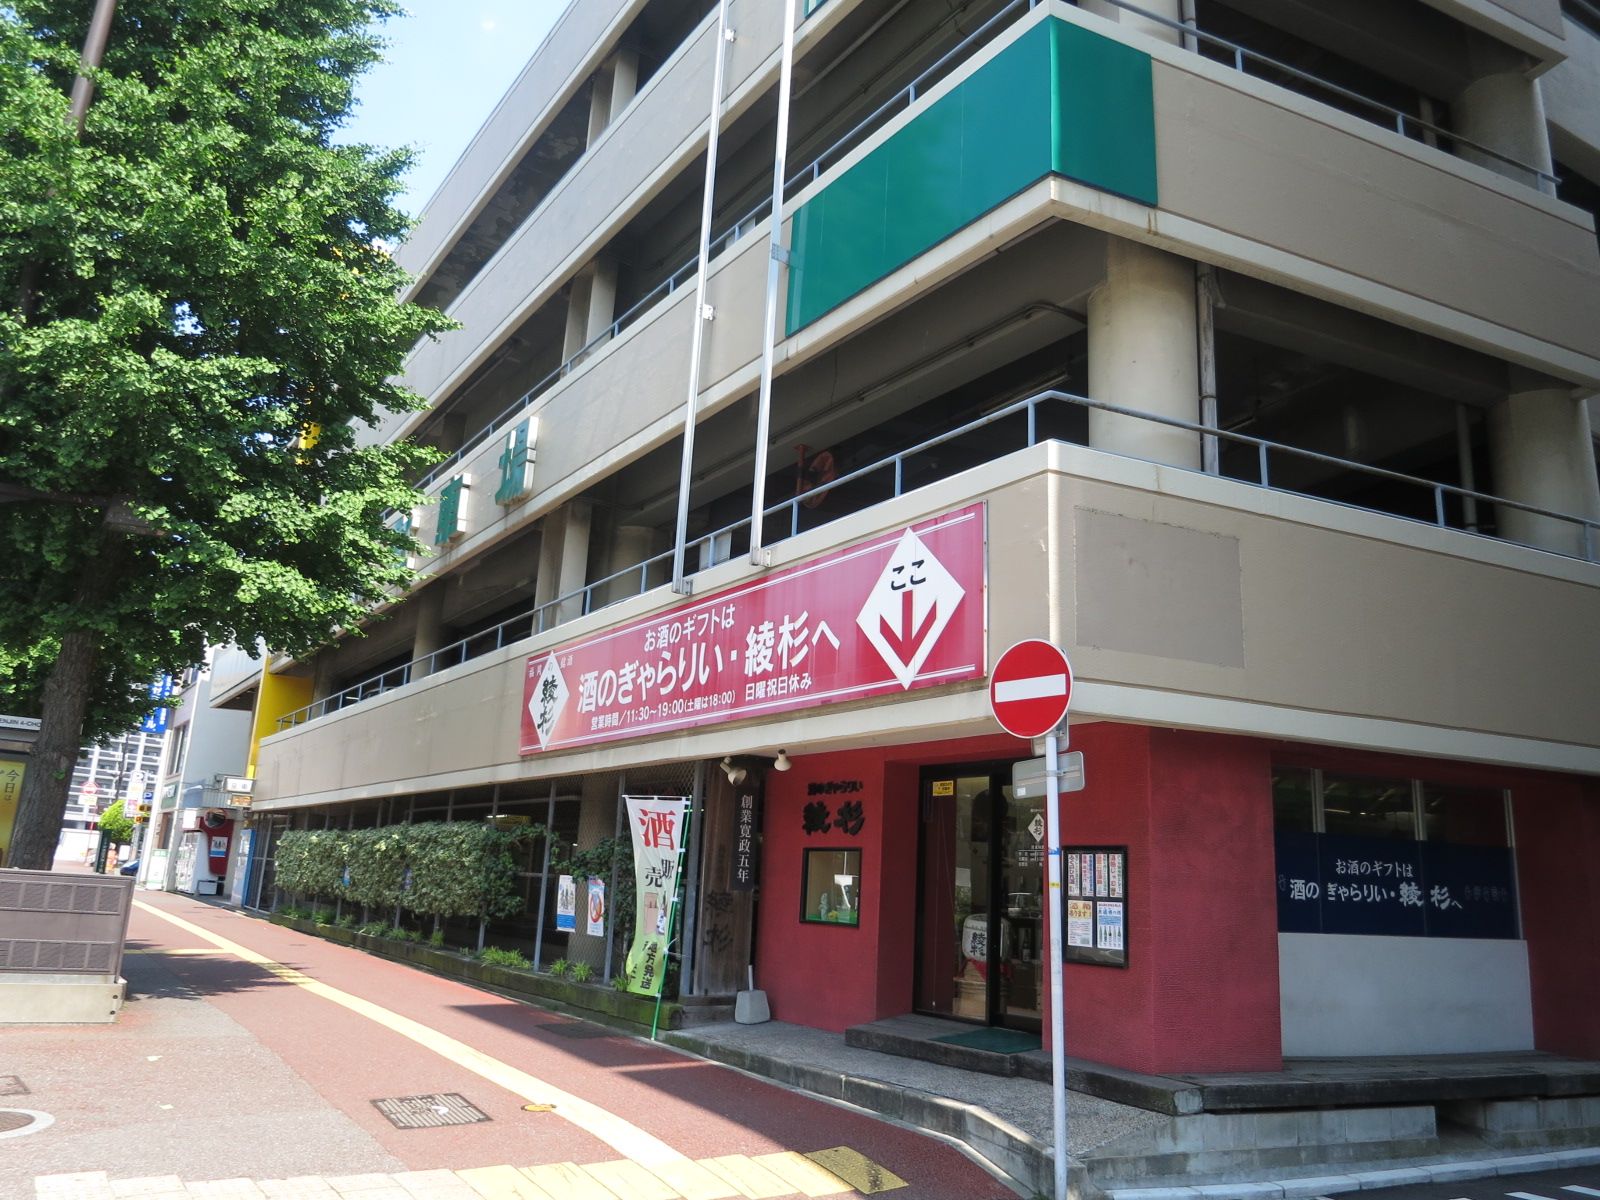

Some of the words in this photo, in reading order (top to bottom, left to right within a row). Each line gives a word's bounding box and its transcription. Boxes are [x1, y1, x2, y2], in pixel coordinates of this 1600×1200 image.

[890, 558, 927, 591] ここ
[643, 603, 737, 652] お酒のギフトは
[576, 610, 841, 714] 酒のぎゃらりい・綾杉へ
[744, 672, 813, 702] 日曜祝日休み
[638, 808, 676, 850] 酒
[1334, 858, 1414, 879] お酒のギフトは
